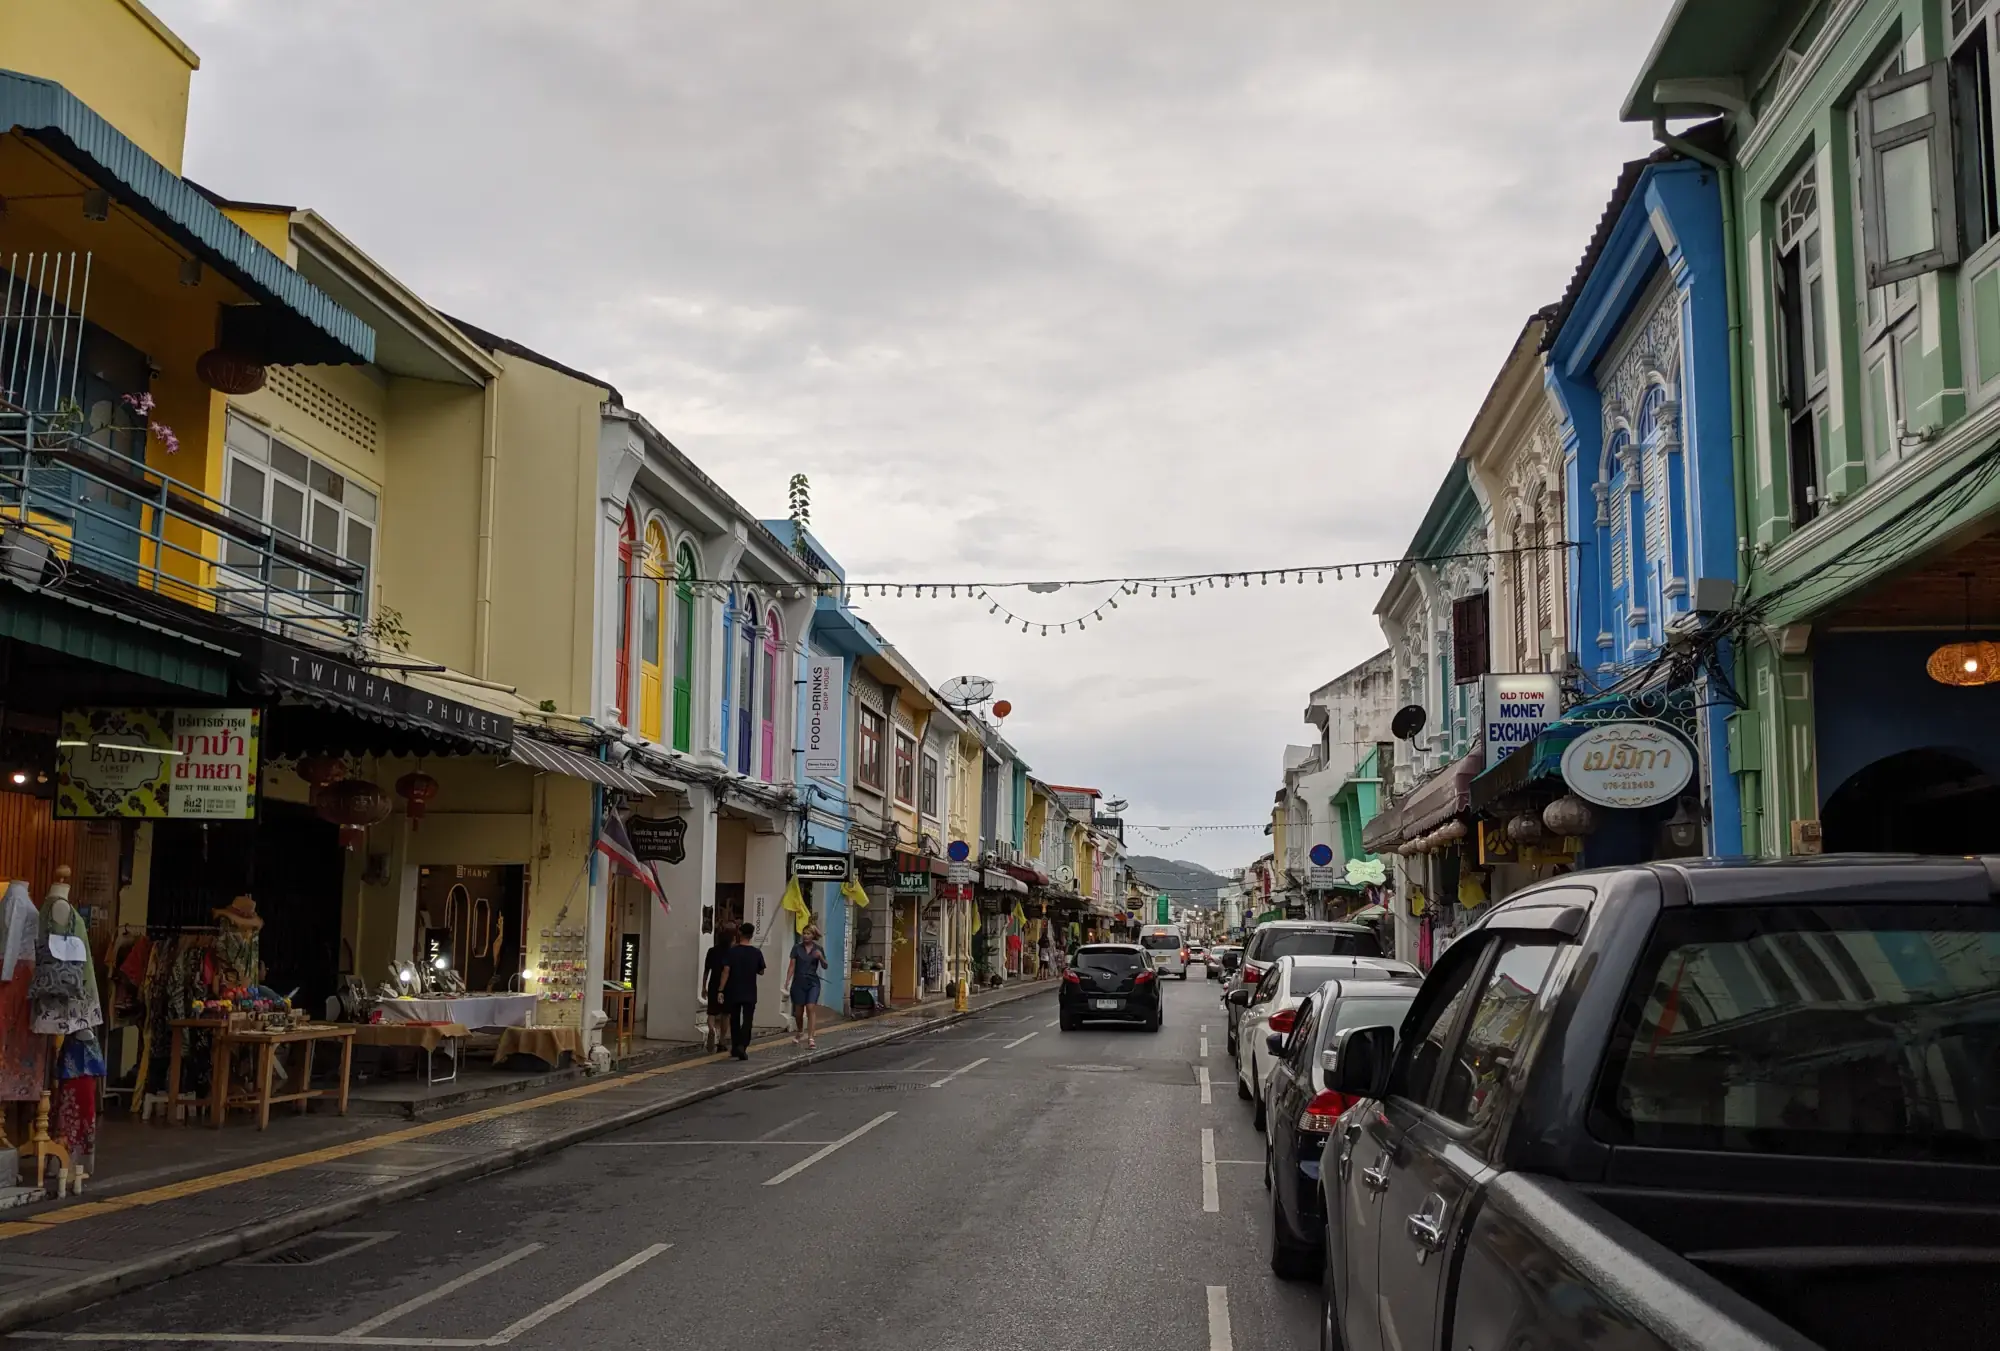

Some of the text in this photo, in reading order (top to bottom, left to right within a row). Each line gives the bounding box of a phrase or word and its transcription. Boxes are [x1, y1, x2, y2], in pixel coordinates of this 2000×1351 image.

[290, 655, 499, 734] TWINHA PHUKET
[1500, 691, 1545, 700] OLD TOWN
[811, 666, 823, 750] FOOD+DRINKS
[1500, 703, 1545, 718] MONEY
[90, 743, 144, 763] BABA
[197, 784, 209, 792] THE
